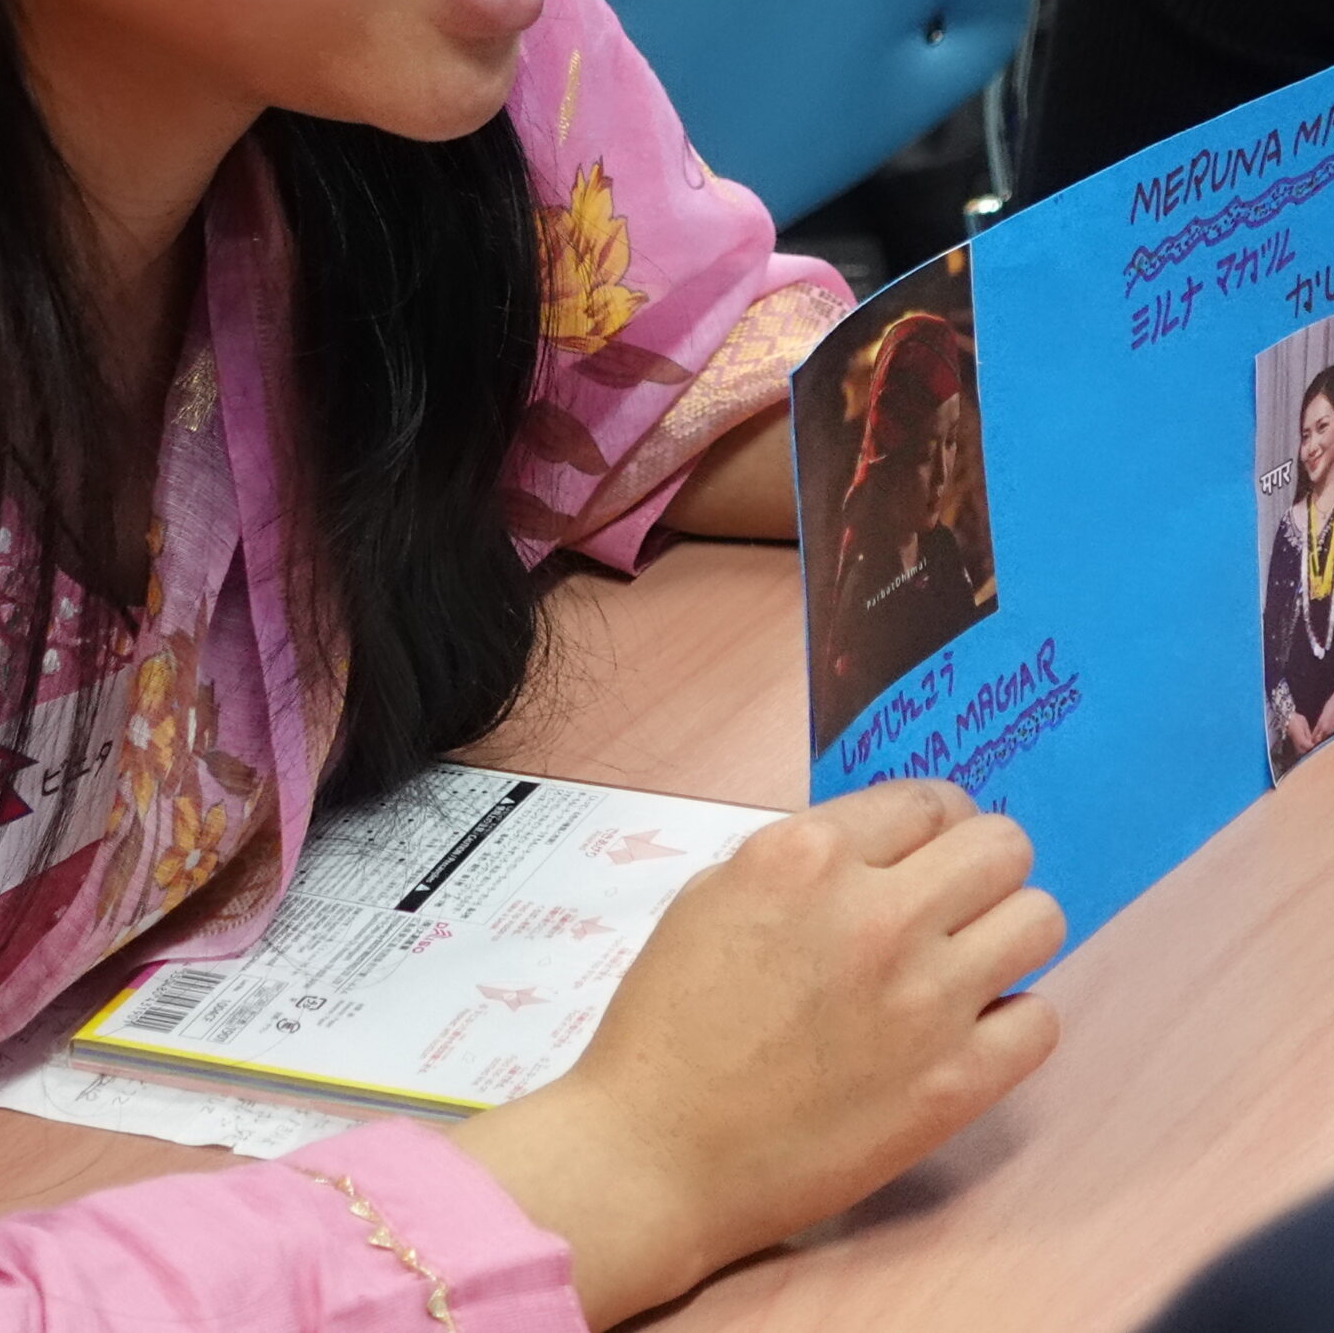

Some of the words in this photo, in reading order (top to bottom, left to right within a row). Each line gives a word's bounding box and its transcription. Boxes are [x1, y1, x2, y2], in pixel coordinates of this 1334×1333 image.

[1130, 129, 1282, 225] MERUNA
[1130, 276, 1204, 350] ミルナ
[1216, 228, 1296, 296] マガル
[1259, 457, 1293, 496] मगर
[956, 637, 1059, 749] MAGAR
[410, 922, 452, 954] DAISO
